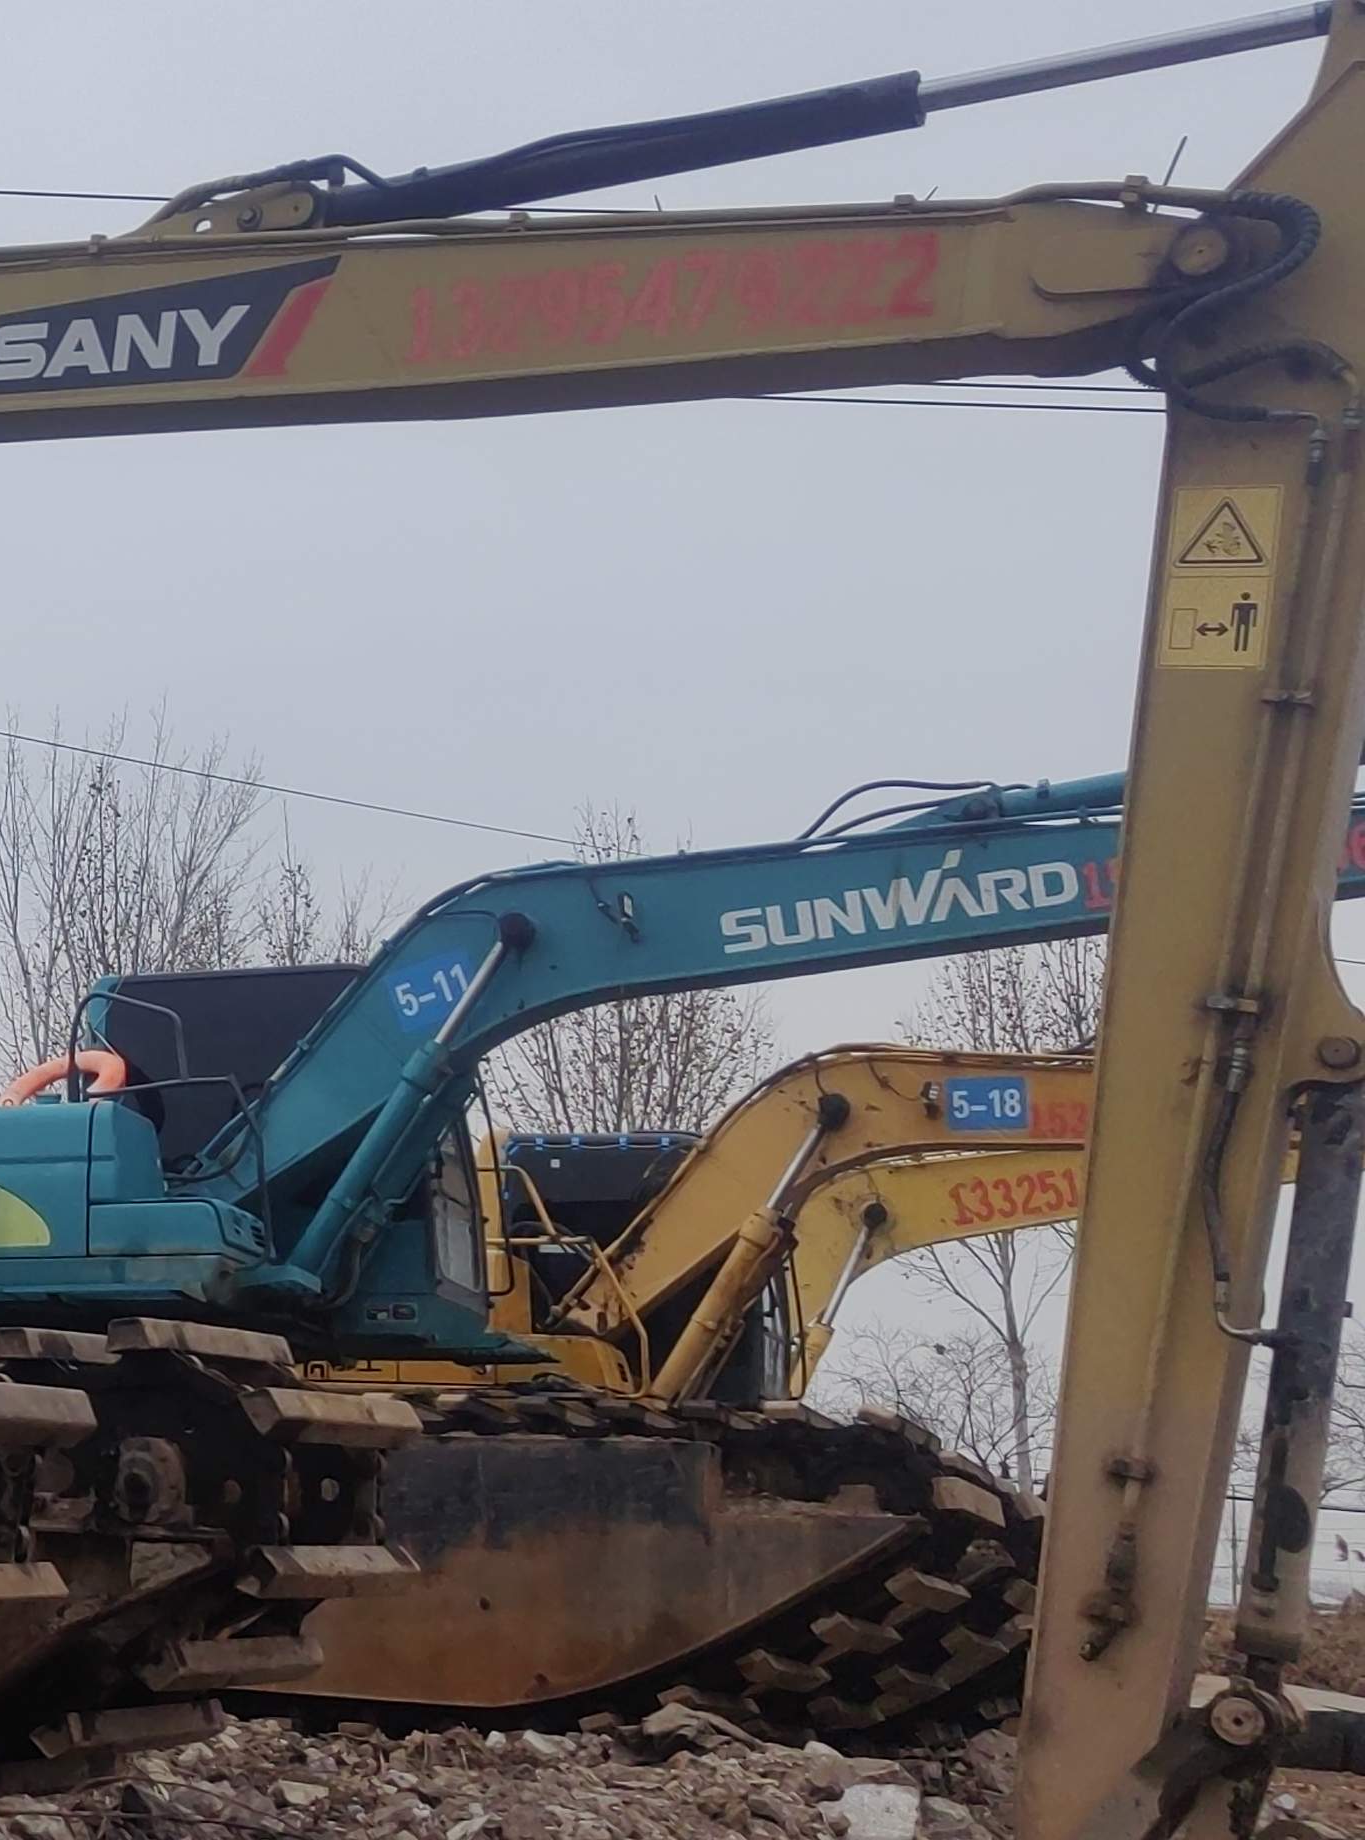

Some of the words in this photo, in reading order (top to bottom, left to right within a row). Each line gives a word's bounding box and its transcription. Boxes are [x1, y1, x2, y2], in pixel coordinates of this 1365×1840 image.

[719, 850, 1079, 954] SUNWARD
[395, 963, 469, 1016] 5-11
[952, 1088, 1022, 1119] 5-18
[949, 1168, 1079, 1226] 133251
